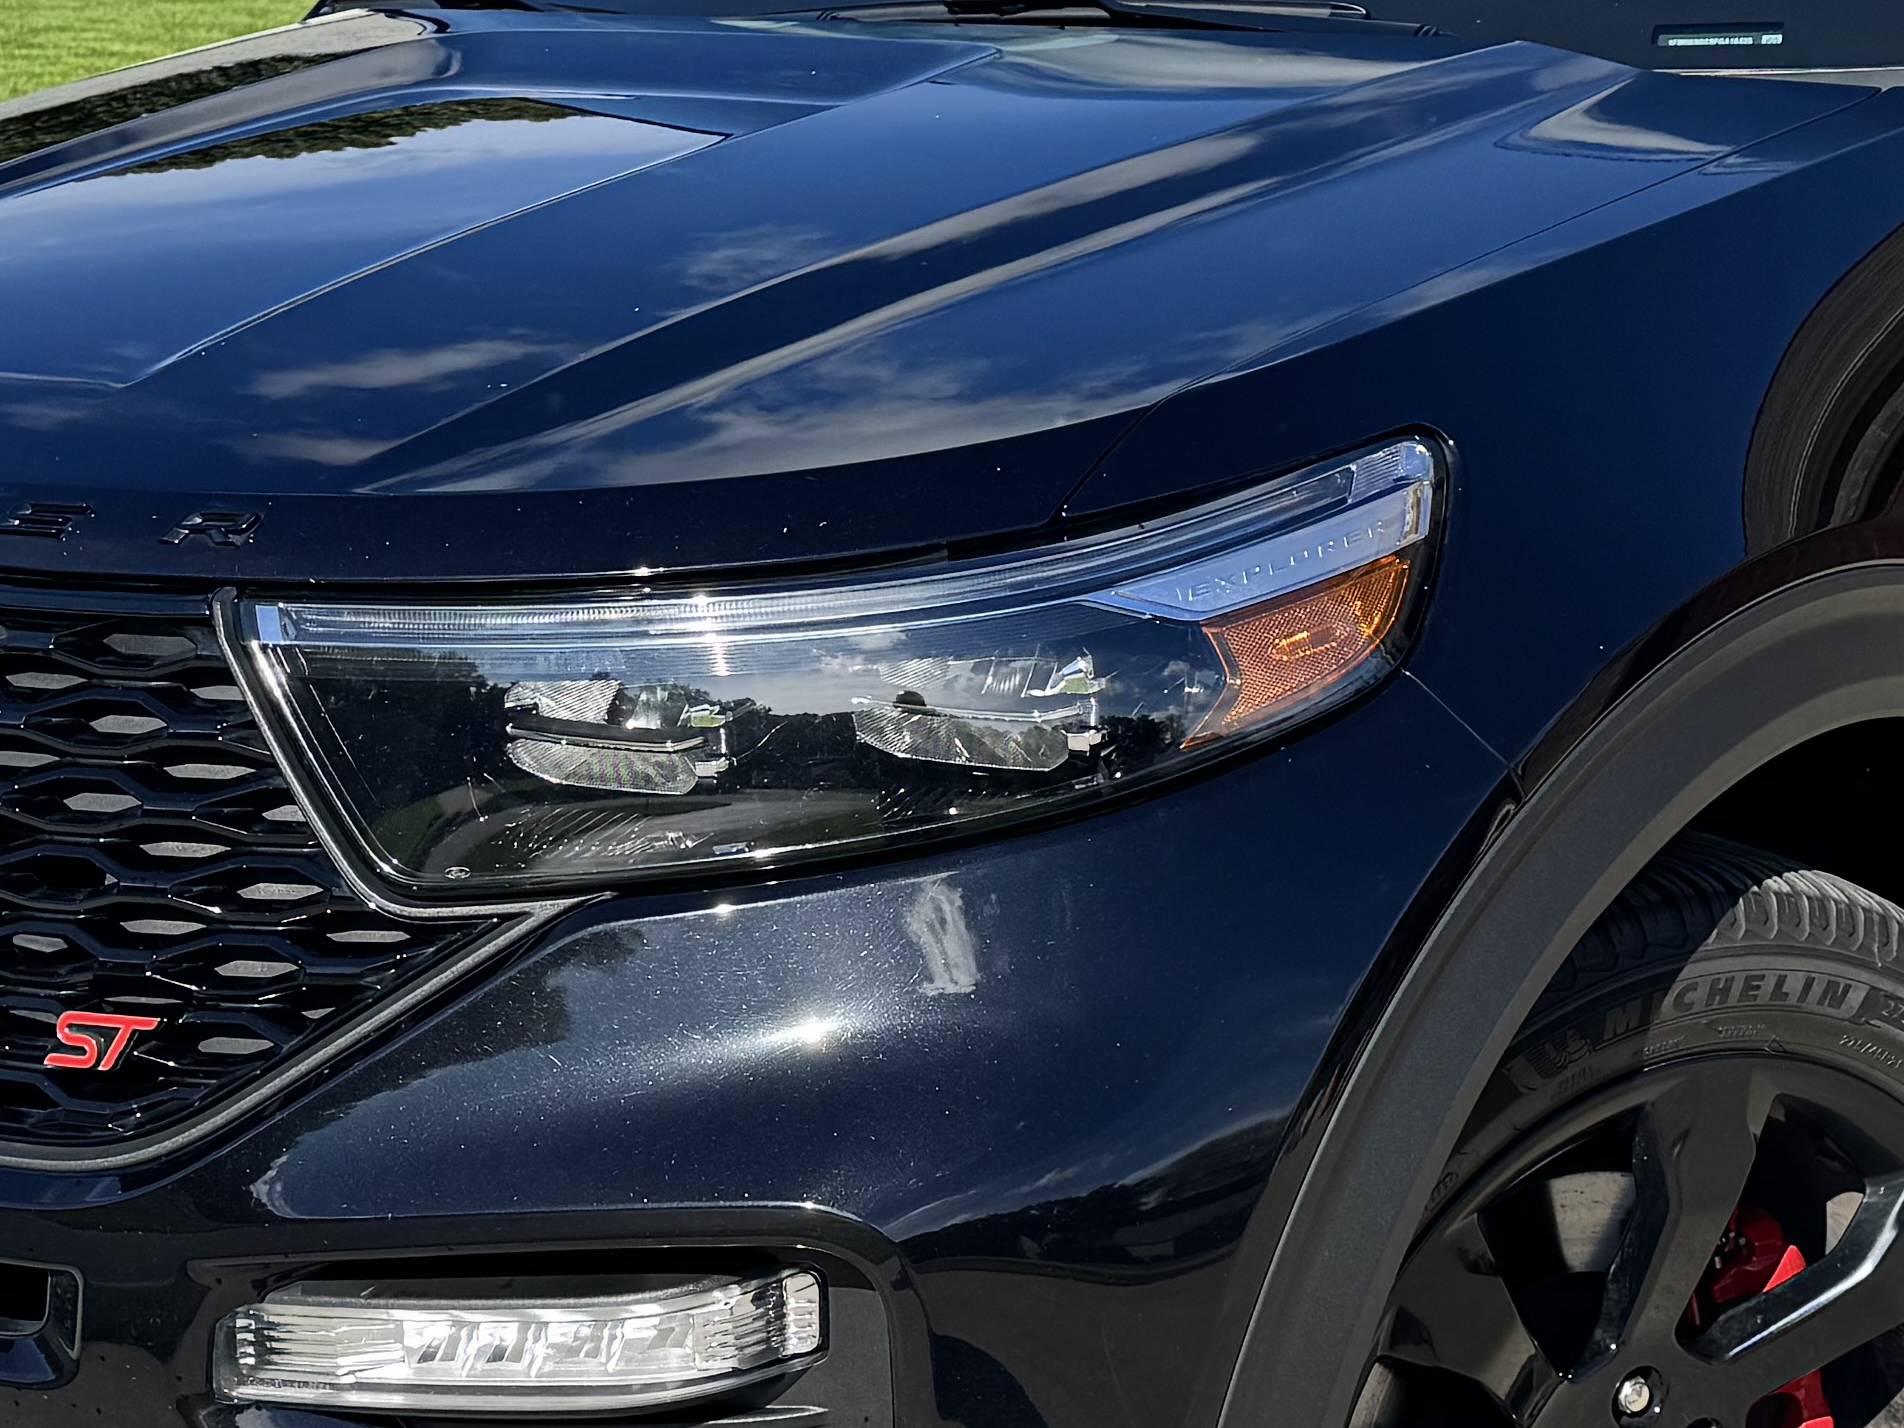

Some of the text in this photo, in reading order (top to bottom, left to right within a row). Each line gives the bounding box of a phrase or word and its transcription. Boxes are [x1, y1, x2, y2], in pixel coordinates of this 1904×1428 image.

[1188, 521, 1385, 601] EXPLORER
[1603, 974, 1852, 1039] MICHELIN
[44, 1011, 161, 1070] ST
